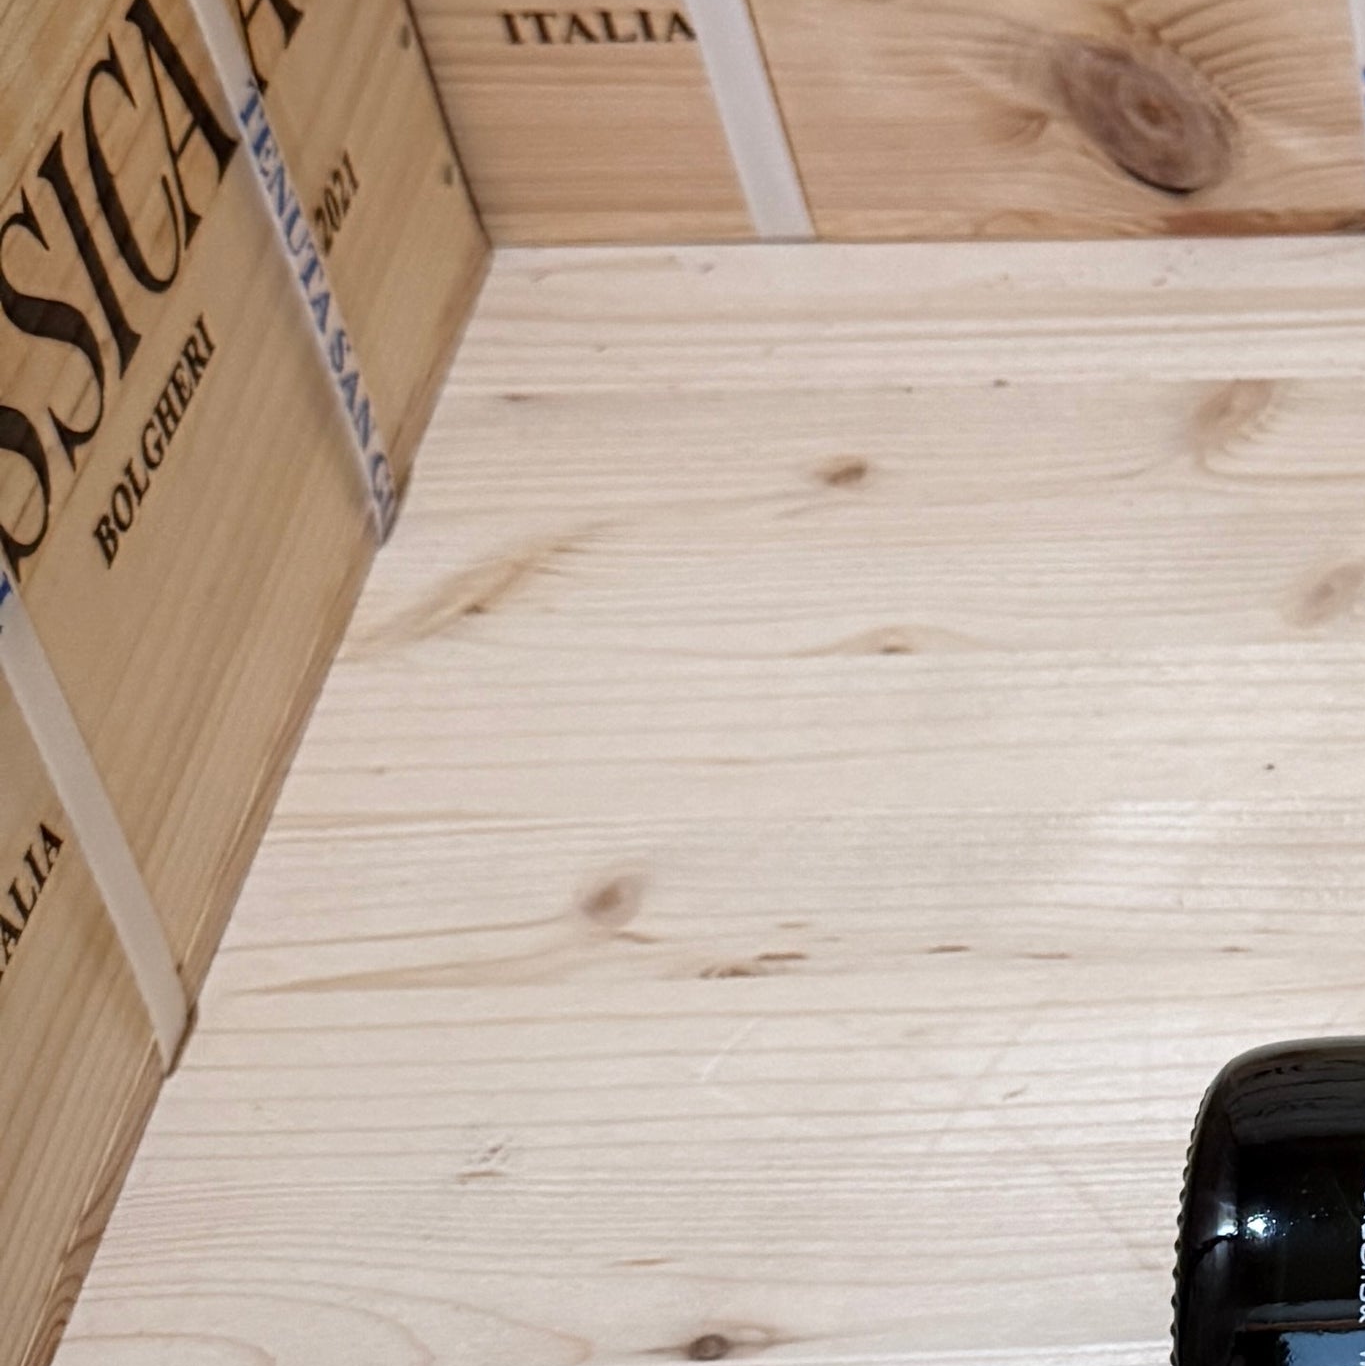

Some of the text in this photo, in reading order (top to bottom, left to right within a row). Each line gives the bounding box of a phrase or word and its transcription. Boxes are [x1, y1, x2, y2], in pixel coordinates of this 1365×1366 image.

[498, 8, 697, 45] ITALIA
[240, 78, 332, 333] TENUTA
[329, 328, 377, 453] SAN
[313, 148, 361, 257] 2021
[93, 313, 217, 568] BOLGHERI
[0, 821, 64, 985] ALIA
